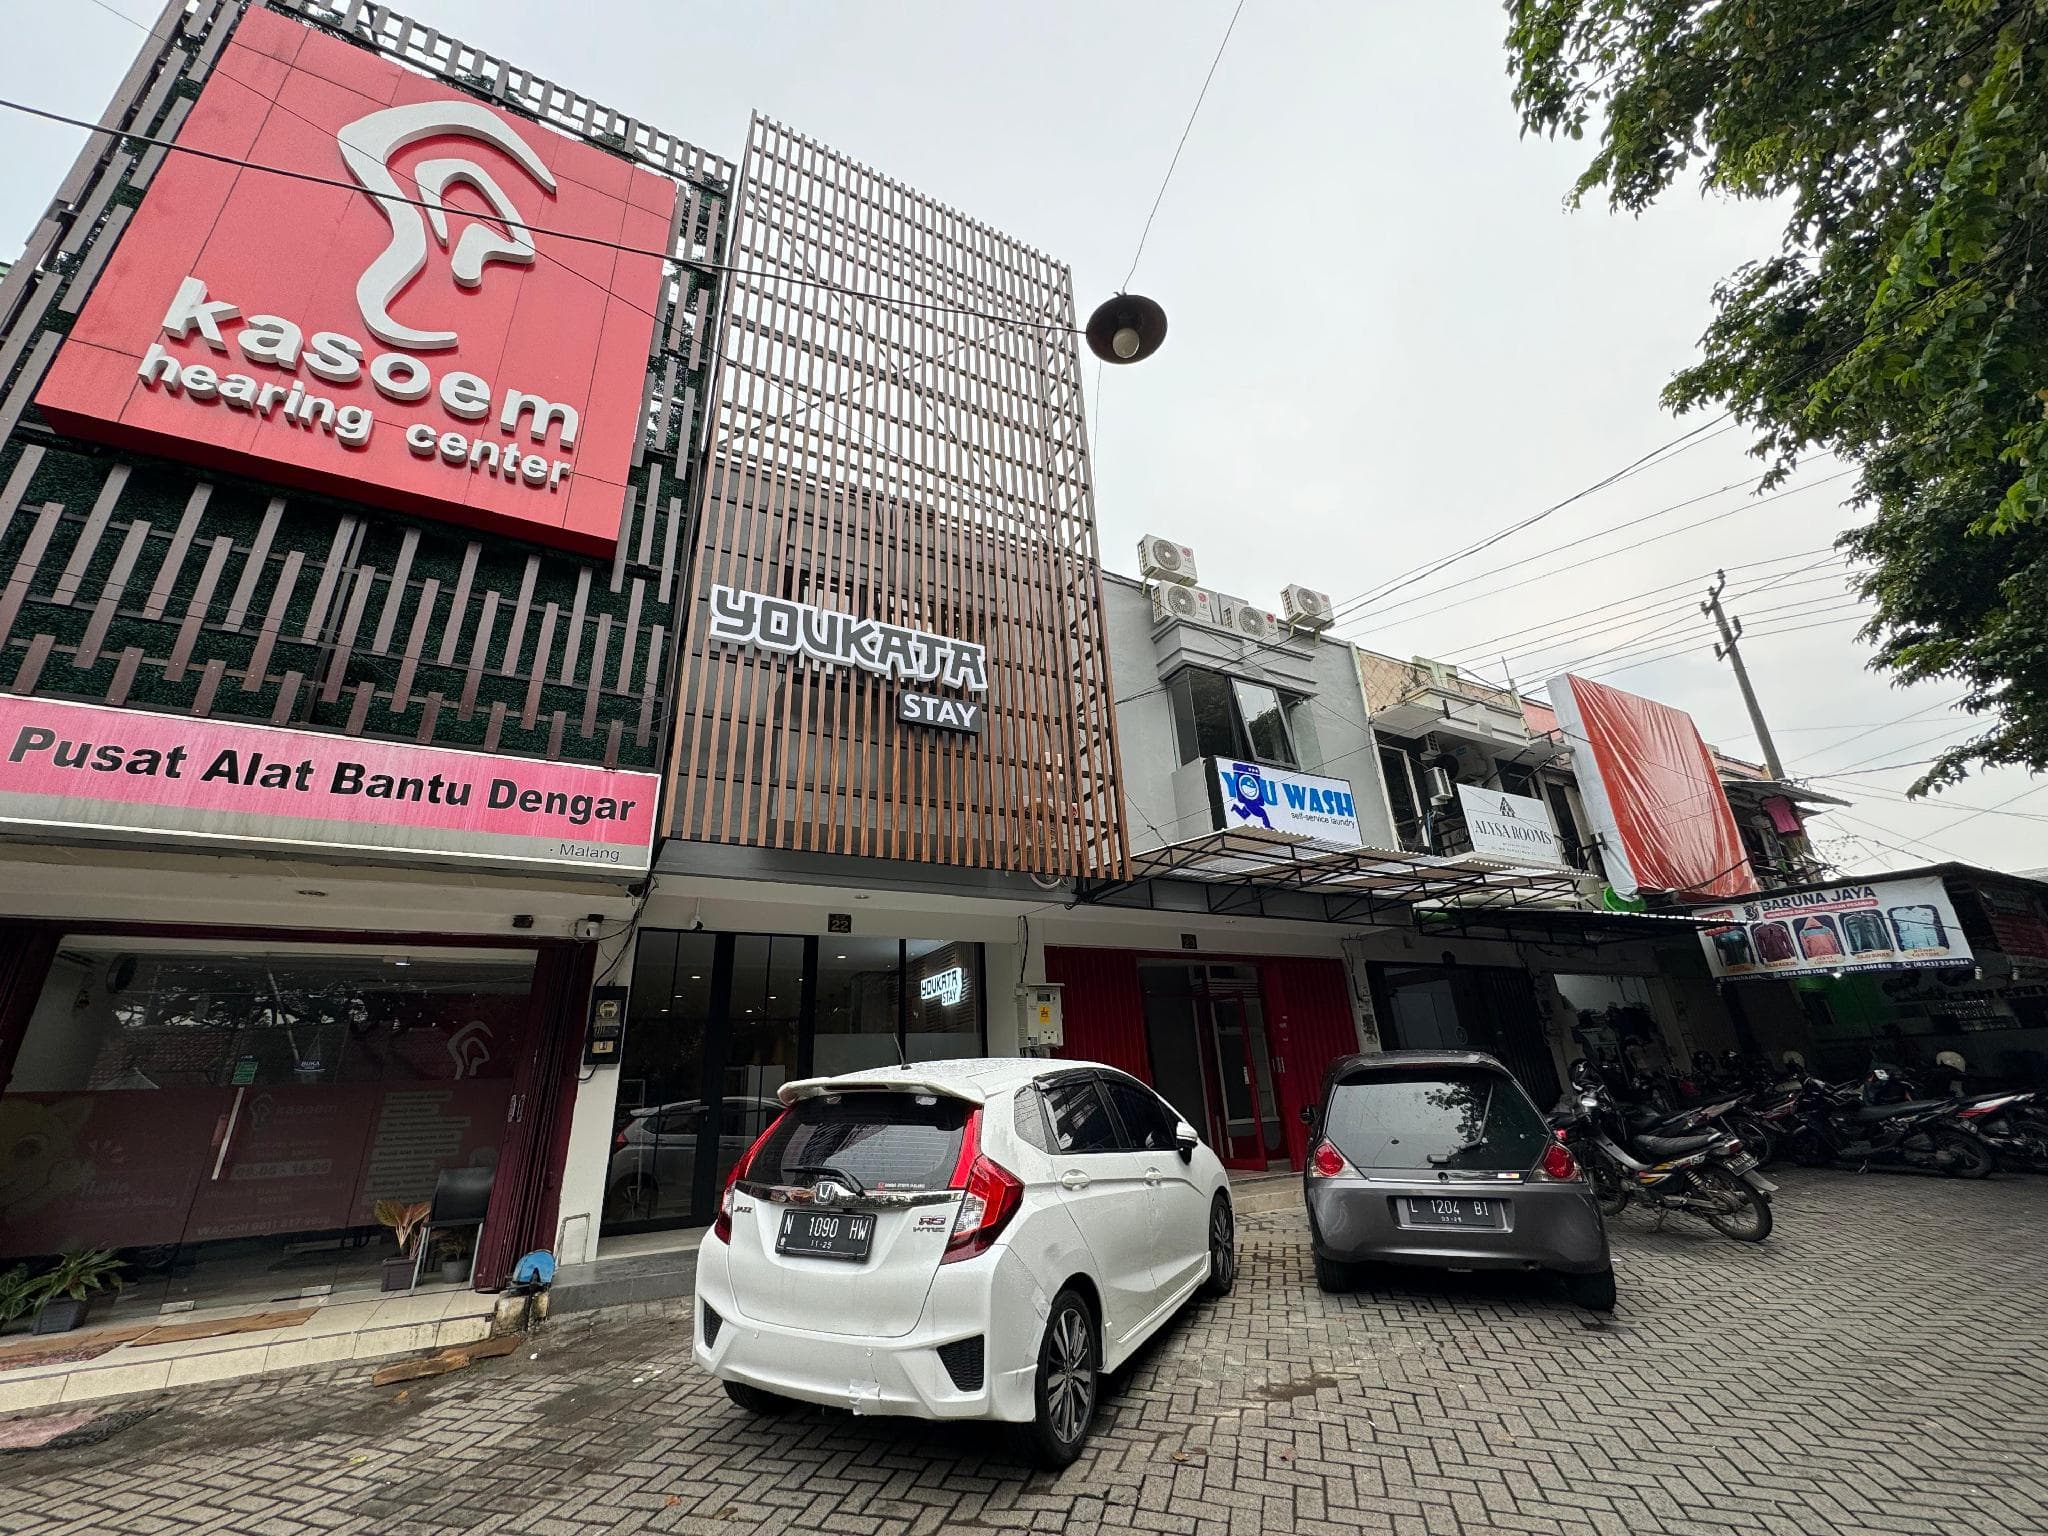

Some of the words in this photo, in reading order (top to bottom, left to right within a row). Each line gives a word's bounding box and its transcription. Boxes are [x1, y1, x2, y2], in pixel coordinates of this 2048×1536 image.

[161, 275, 580, 448] kasoem
[137, 342, 375, 447] hearing
[405, 420, 573, 489] center
[709, 583, 988, 692] YOUKATA
[903, 693, 977, 728] STAY
[7, 725, 190, 779] Pusat
[200, 750, 316, 793] Alat
[329, 762, 473, 809] Bantu
[486, 776, 637, 825] Dengar
[1281, 782, 1355, 818] WASH
[1475, 819, 1511, 839] ALYSA
[1511, 824, 1552, 845] ROOMS
[558, 842, 621, 863] Malang
[1760, 891, 1829, 912] BARUNA
[1830, 885, 1877, 902] JAYA
[831, 919, 849, 932] 22
[921, 969, 958, 997] YOUKATA
[942, 987, 958, 1004] STAY
[734, 1206, 754, 1214] JAZZ
[919, 1215, 946, 1226] RS
[1409, 1198, 1419, 1213] L
[1430, 1199, 1460, 1215] 1204
[1473, 1200, 1489, 1216] BI
[783, 1214, 795, 1235] N
[808, 1216, 840, 1239] 1090
[849, 1219, 870, 1241] HW
[810, 1239, 833, 1250] 11-25
